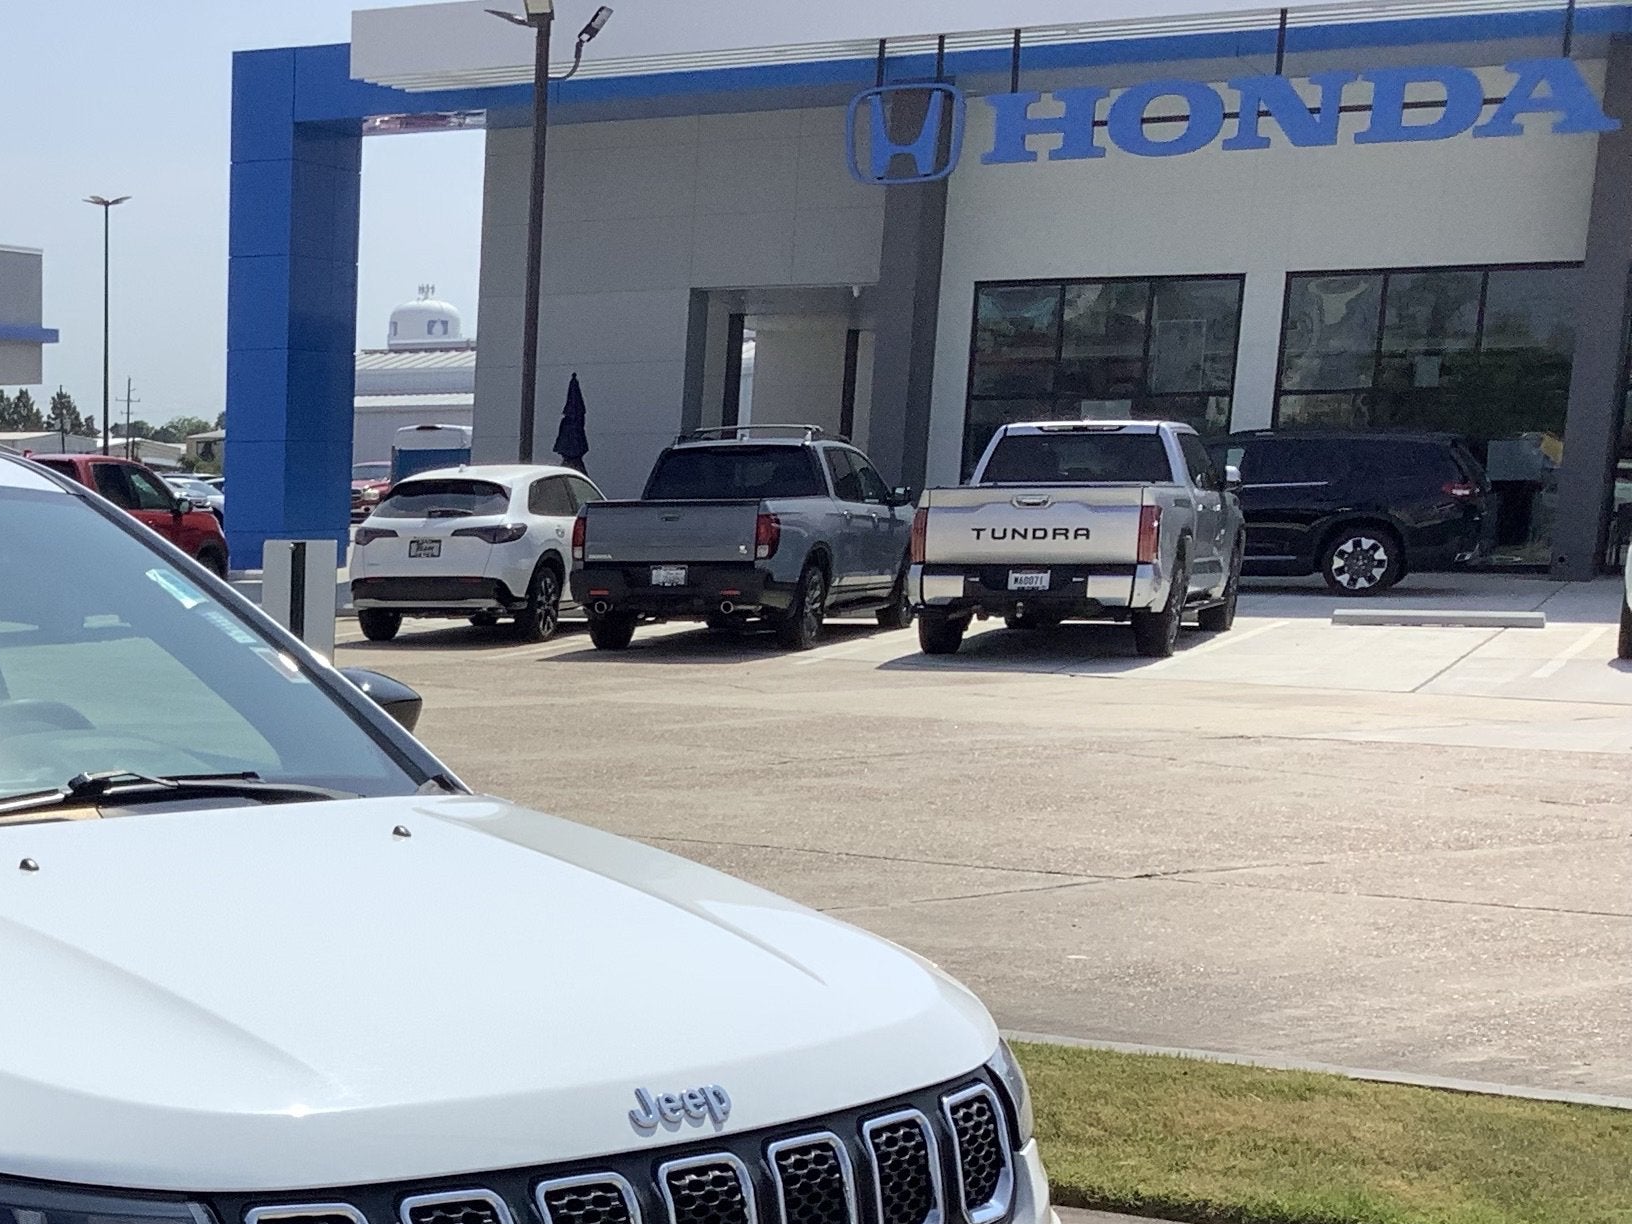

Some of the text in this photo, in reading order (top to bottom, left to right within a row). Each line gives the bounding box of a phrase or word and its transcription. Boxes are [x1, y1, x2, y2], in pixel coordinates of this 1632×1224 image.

[980, 56, 1622, 166] HONDA
[971, 527, 1091, 540] TUNDRA
[628, 1084, 732, 1128] Jeep
